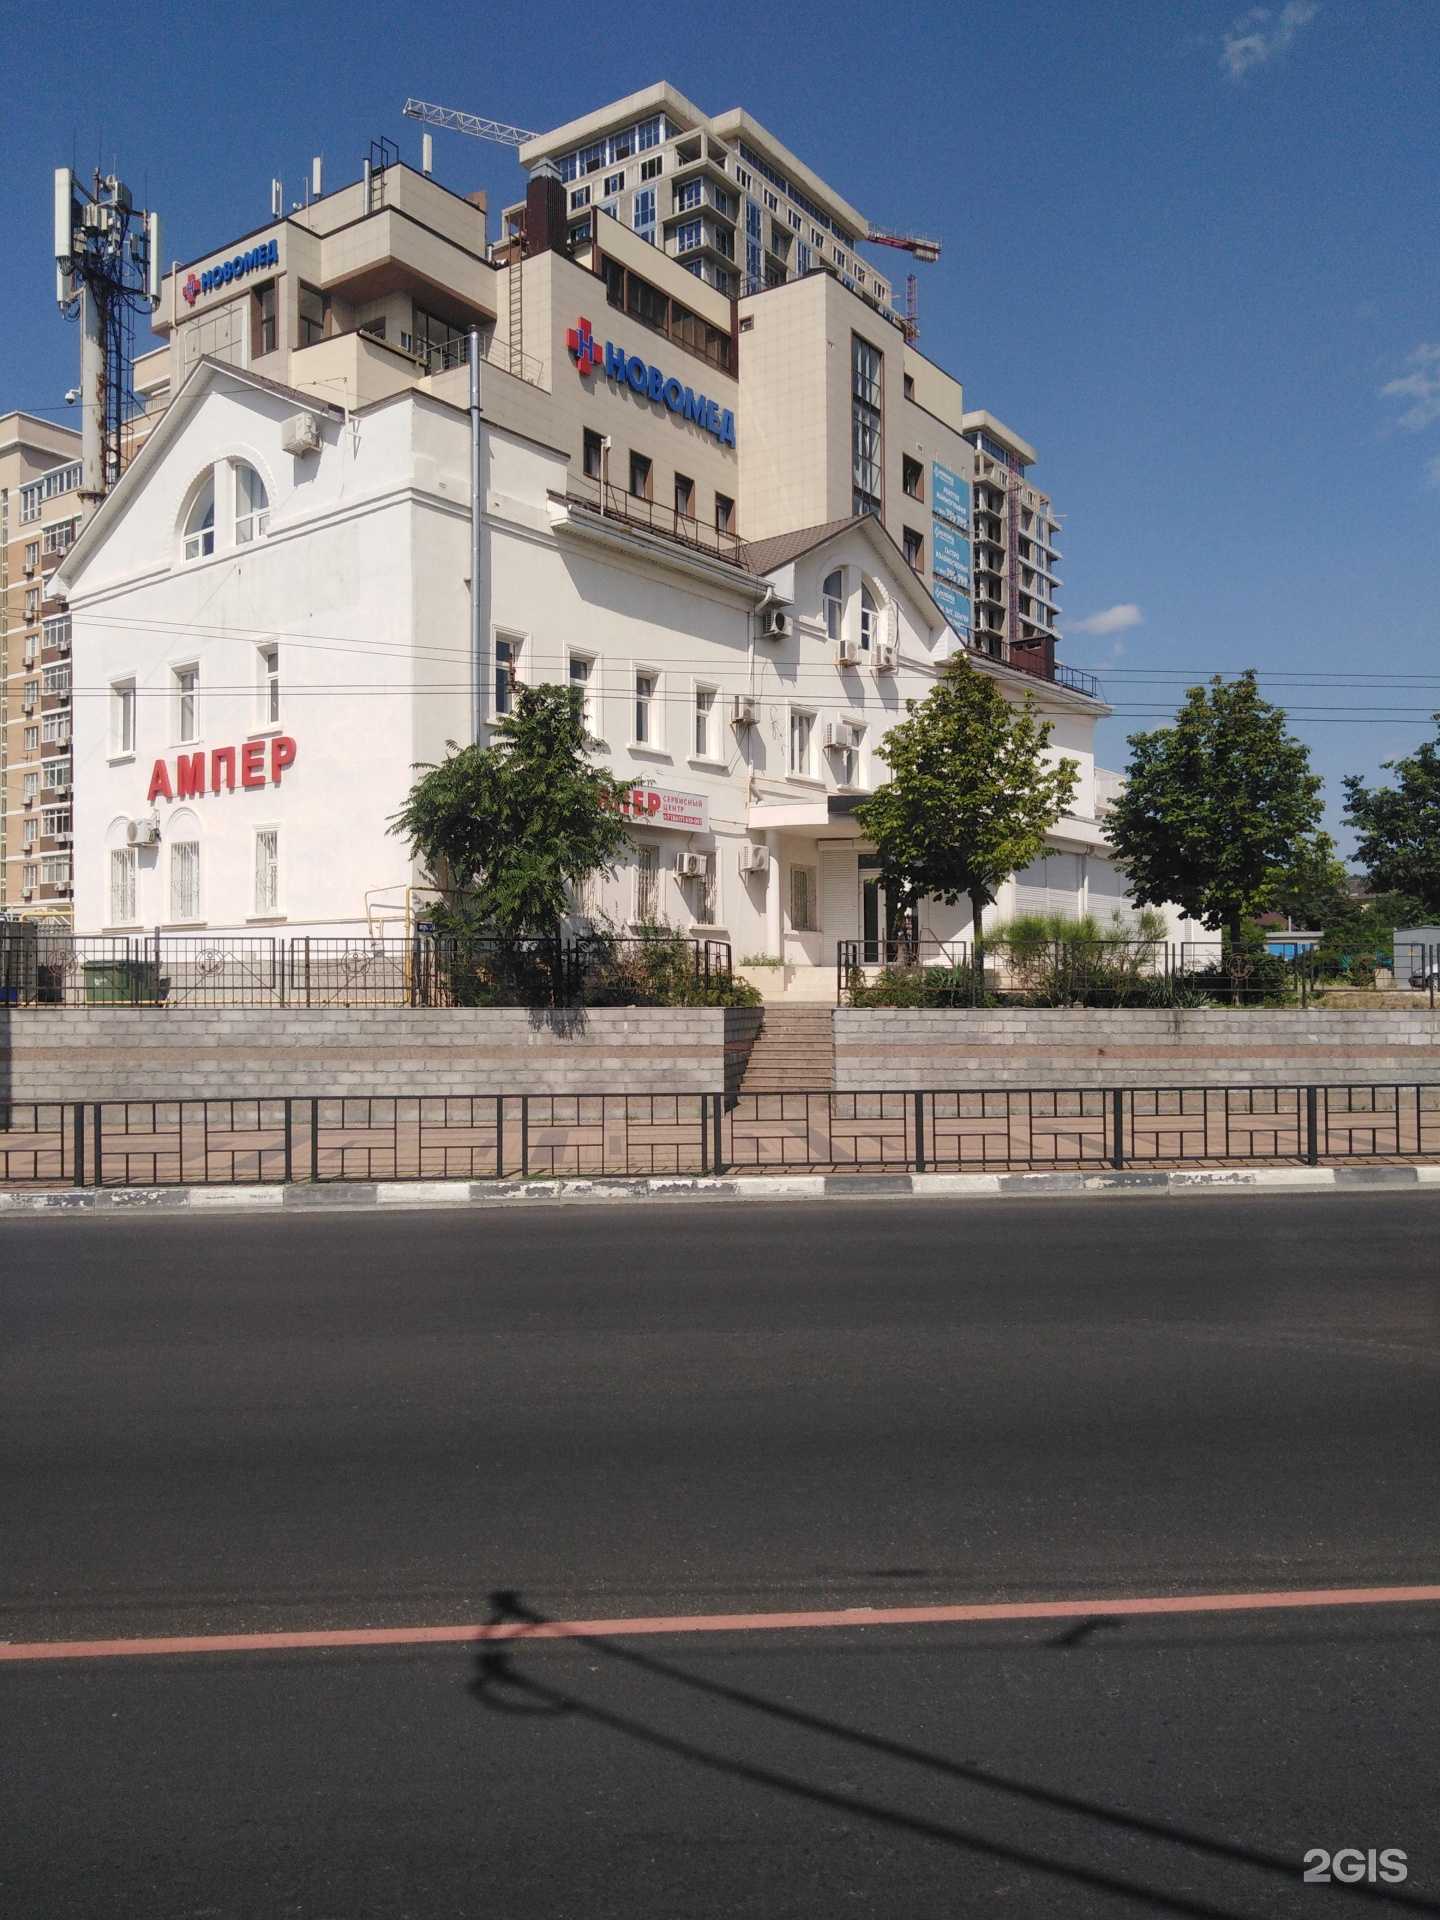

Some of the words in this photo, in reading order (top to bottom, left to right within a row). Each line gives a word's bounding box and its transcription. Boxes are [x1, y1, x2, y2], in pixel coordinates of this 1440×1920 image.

[201, 238, 279, 295] НОВОМЕД
[605, 340, 737, 449] НОВОМЕД
[147, 736, 298, 804] АМПЕР
[662, 795, 703, 808] СЕРВИСНЫЙ
[663, 804, 684, 812] ЦЕНТР
